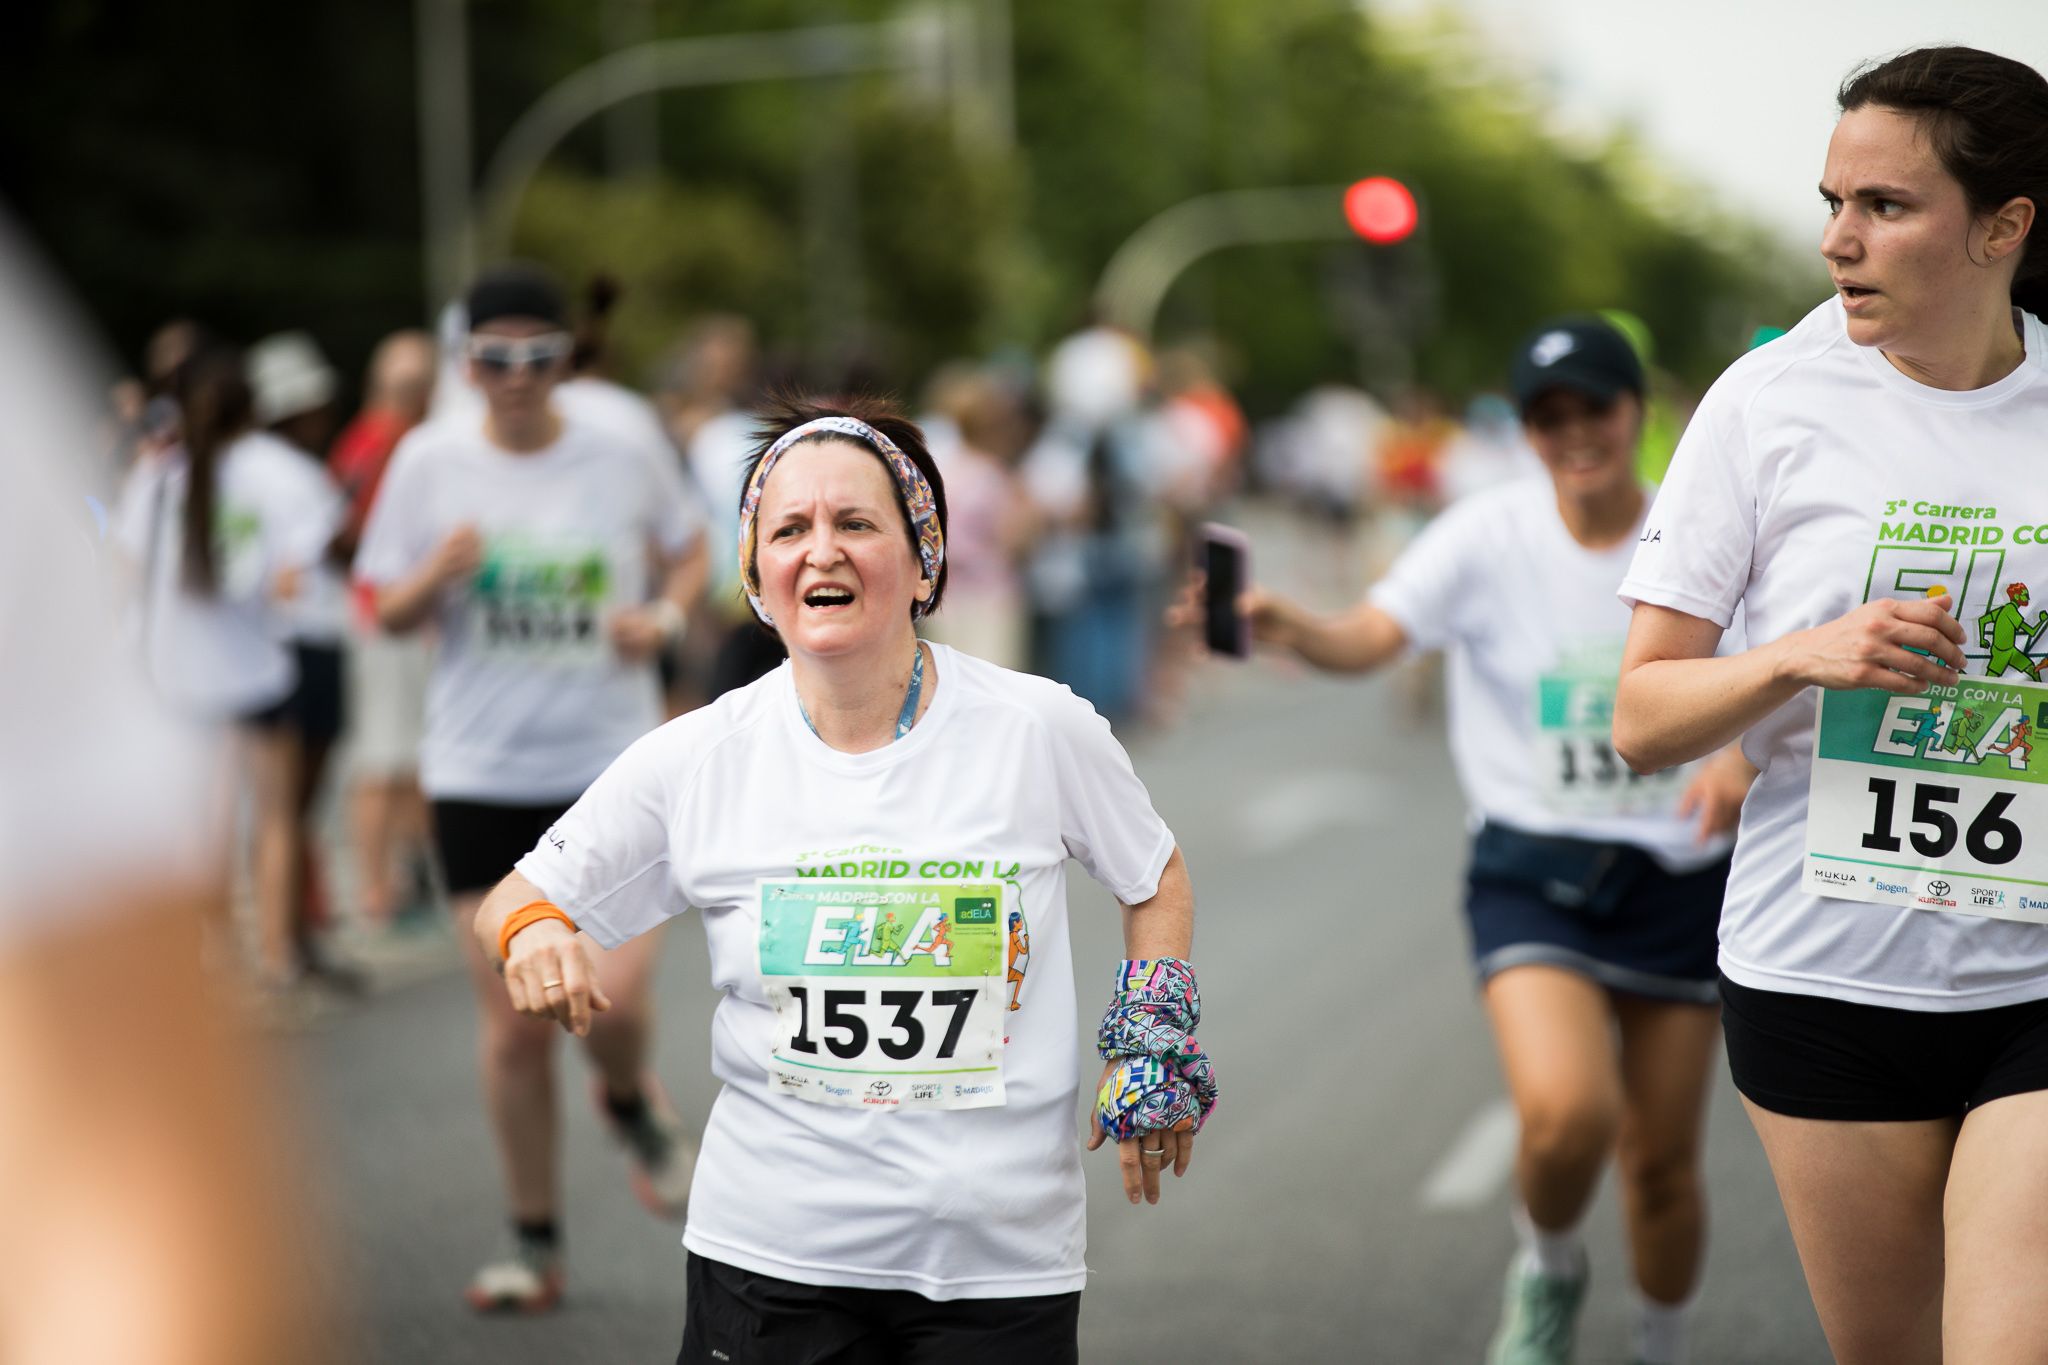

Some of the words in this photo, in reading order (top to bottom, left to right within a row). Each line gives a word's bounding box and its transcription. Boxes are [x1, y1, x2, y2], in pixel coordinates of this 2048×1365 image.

[1913, 501, 1997, 519] Carrera
[1878, 522, 2004, 545] MADRID
[2013, 525, 2048, 545] CO
[1963, 688, 1999, 703] CON
[2002, 692, 2023, 705] LA
[1873, 696, 2027, 771] ELA
[1862, 777, 2022, 865] 156
[796, 860, 911, 879] MADRID
[919, 861, 983, 878] CON
[1815, 869, 1856, 882] MUKUA
[1876, 881, 1908, 894] Biogen
[1971, 887, 1999, 898] SPORT
[817, 891, 878, 904] MADRID
[884, 891, 916, 904] CON
[920, 892, 940, 904] LA
[1973, 896, 1994, 906] LIFE
[961, 909, 992, 919] adELA
[802, 906, 952, 967] ELA
[788, 986, 979, 1061] 1537
[911, 1083, 936, 1091] SPORT
[914, 1091, 934, 1099] LIFE
